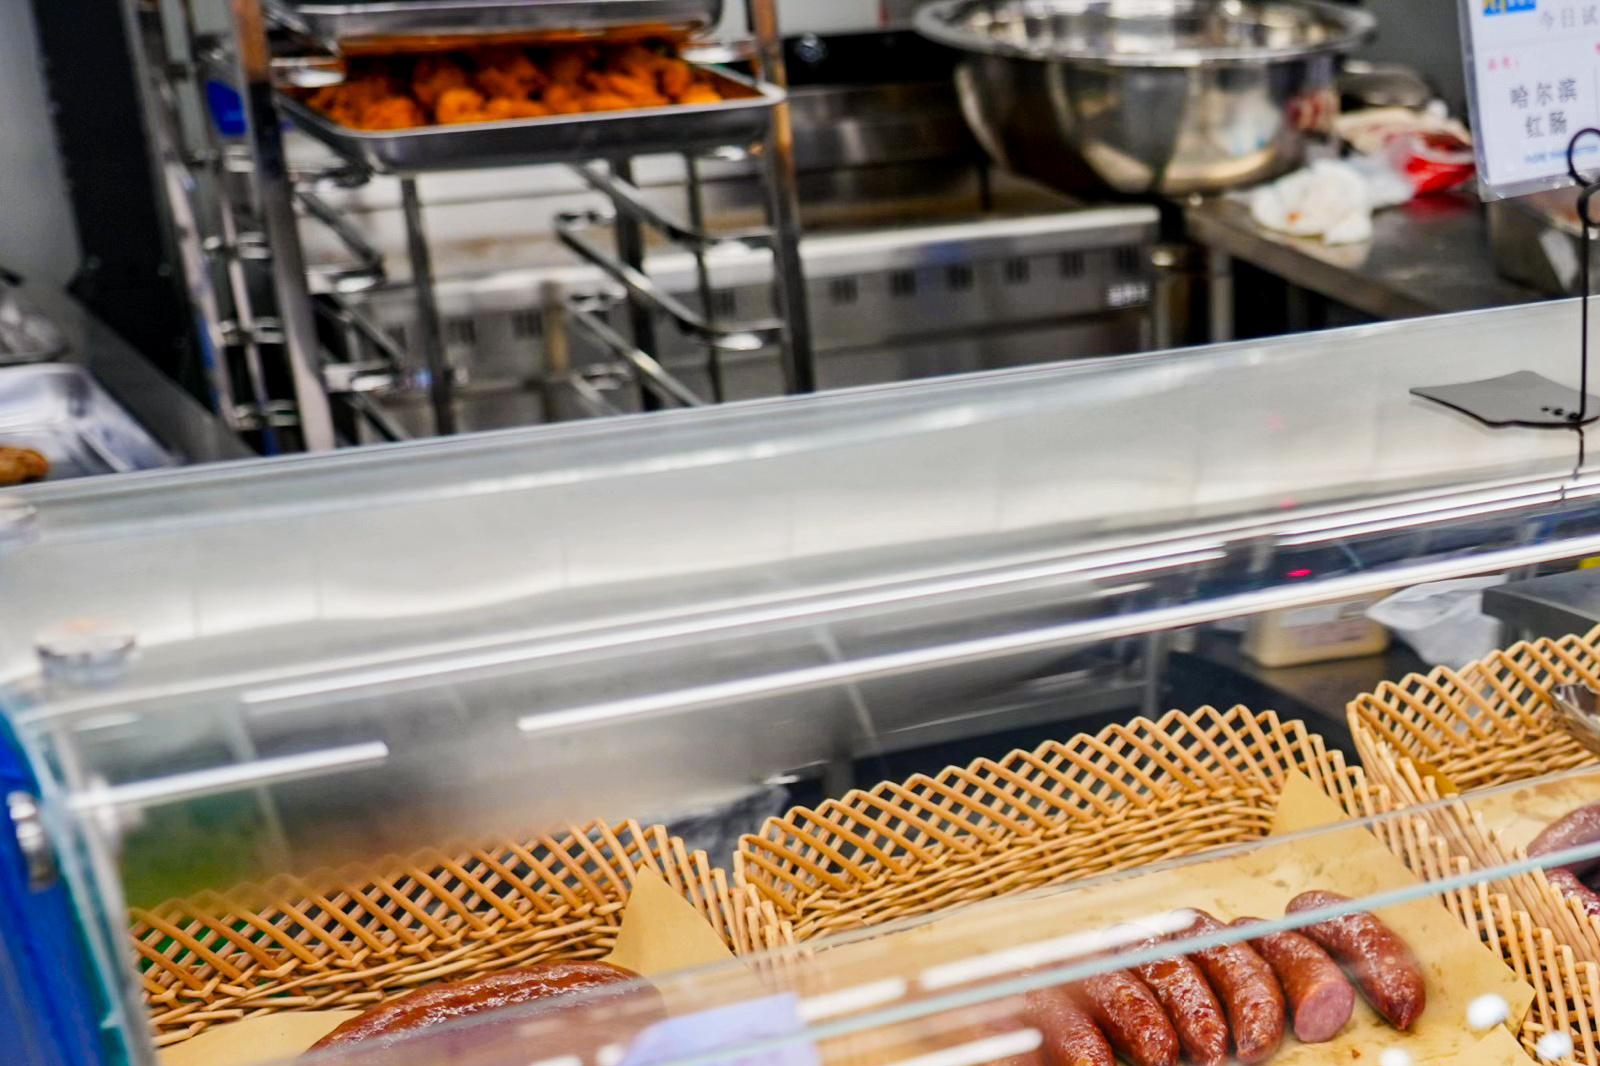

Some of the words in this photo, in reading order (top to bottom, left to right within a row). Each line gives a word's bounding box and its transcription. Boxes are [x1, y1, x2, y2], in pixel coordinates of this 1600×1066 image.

[1509, 78, 1577, 109] 哈尔滨
[1525, 111, 1568, 138] 红肠
